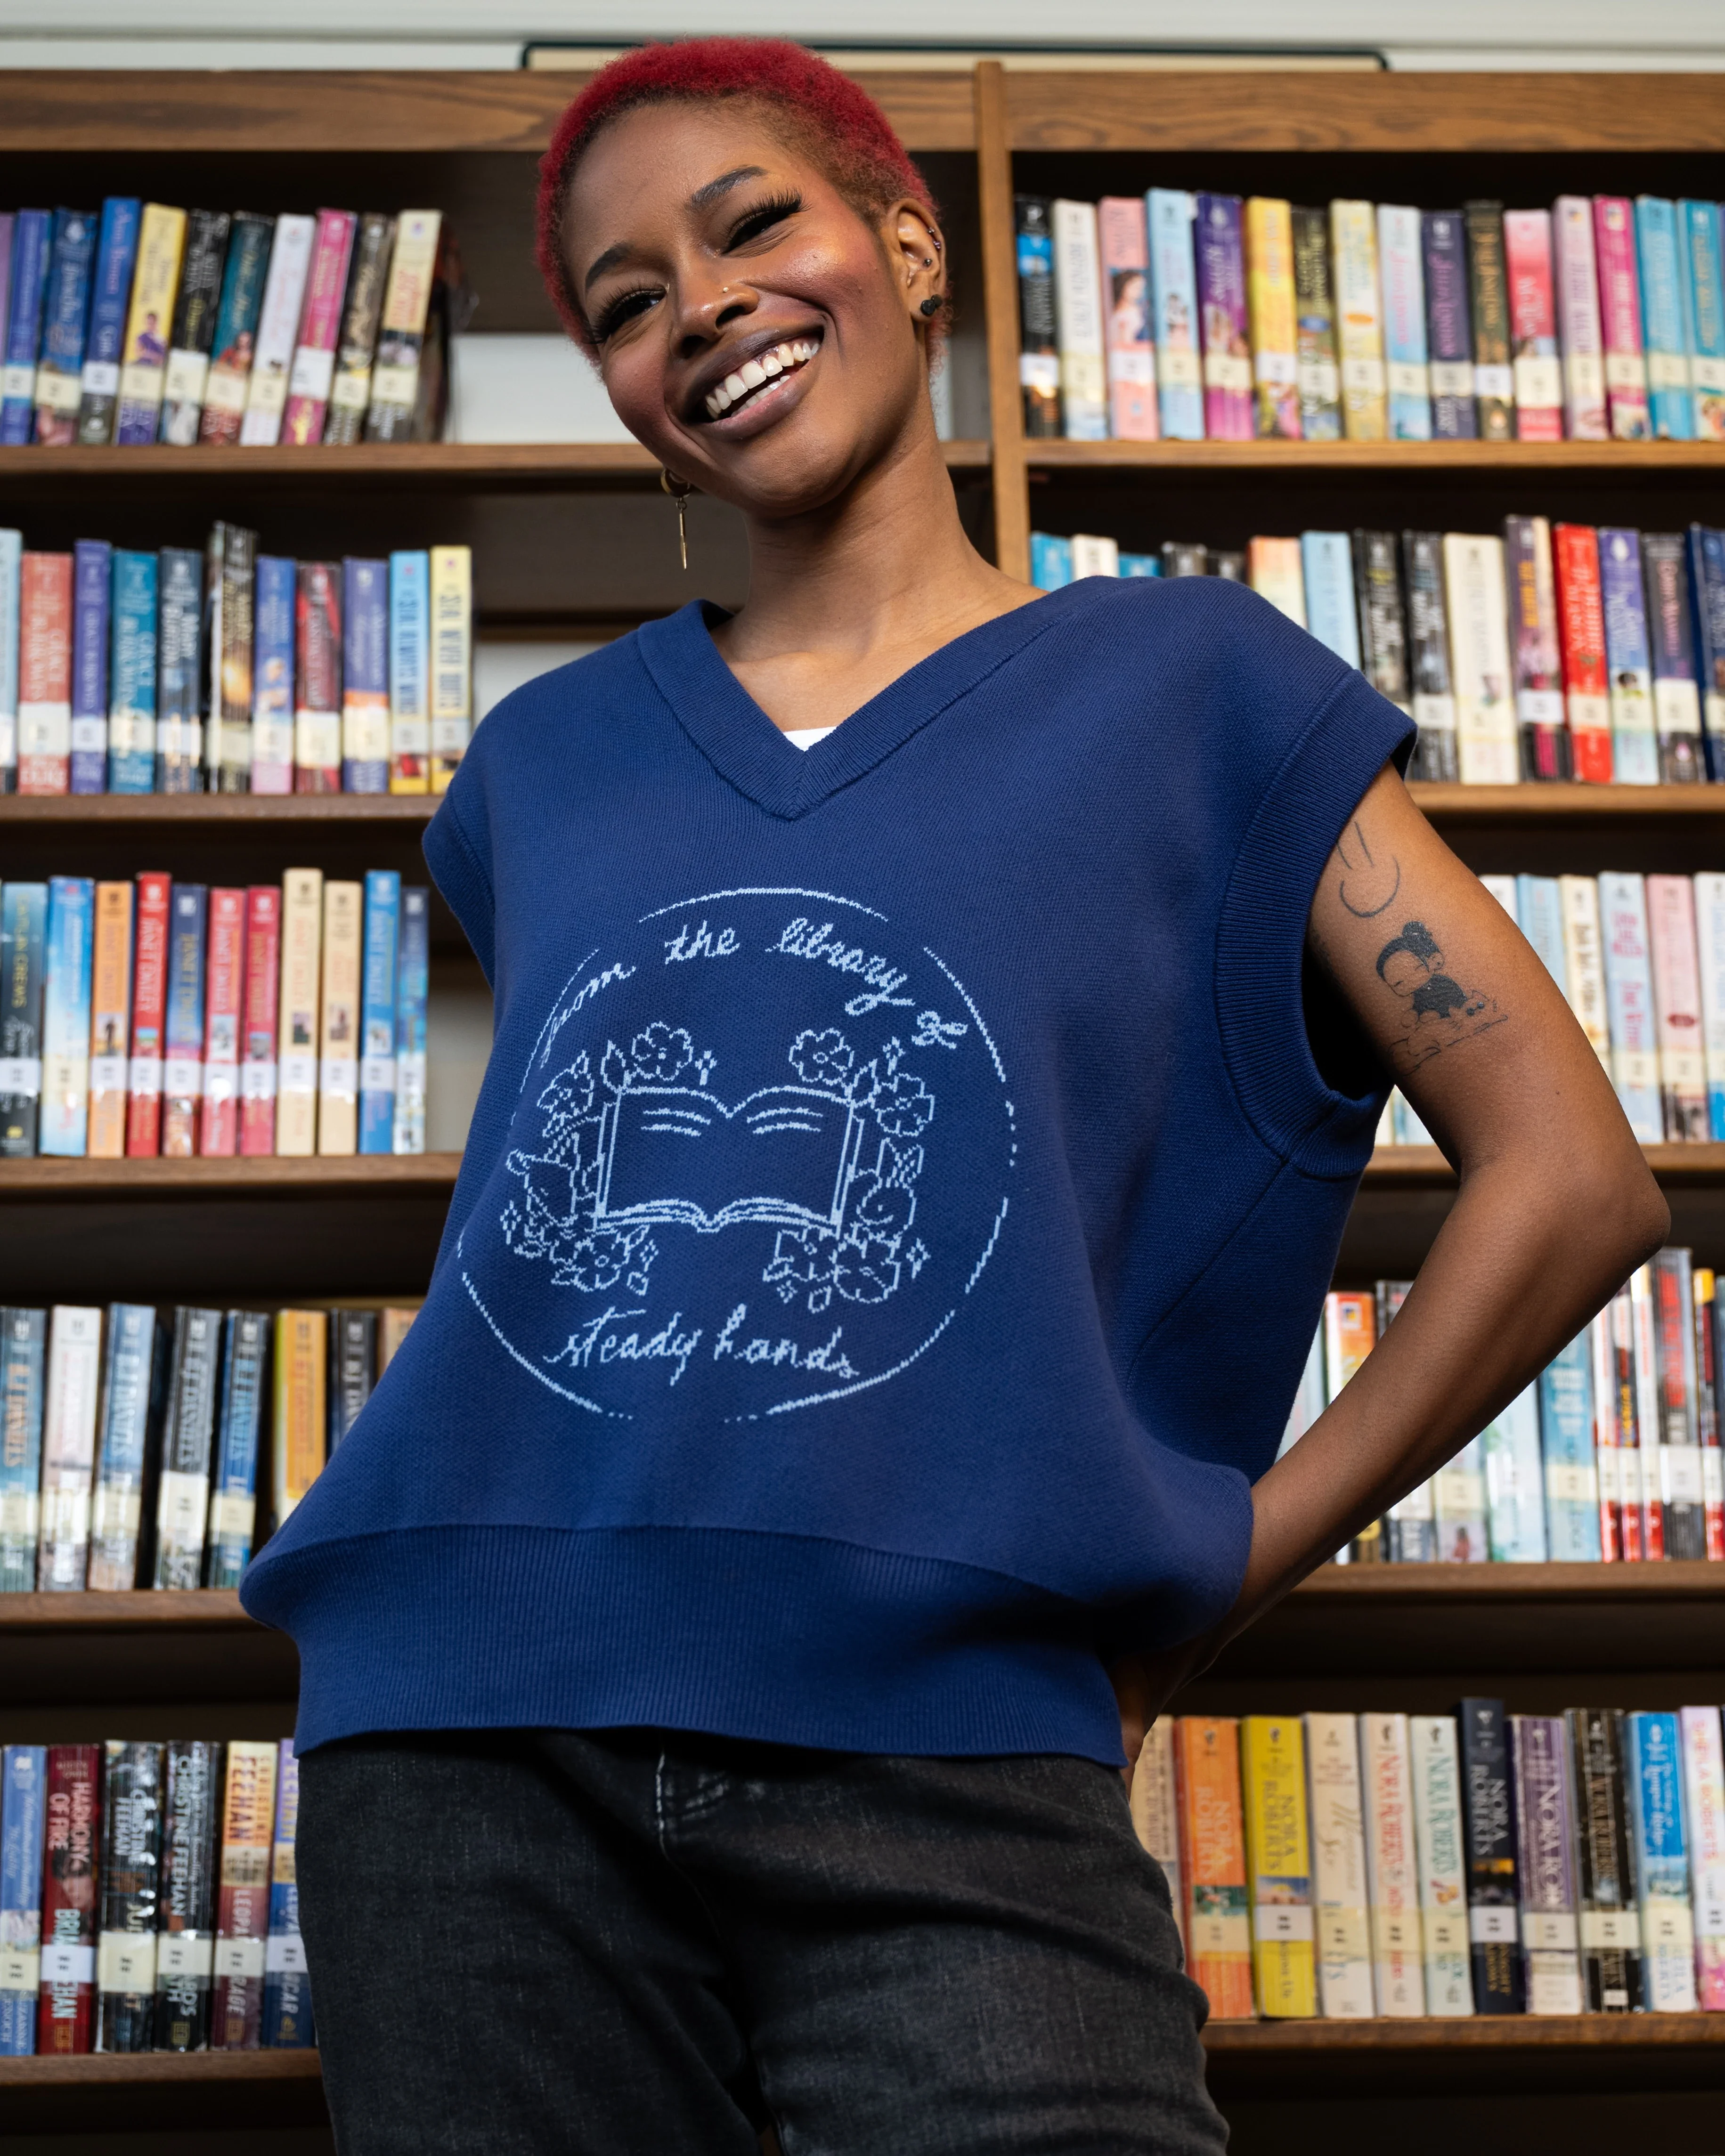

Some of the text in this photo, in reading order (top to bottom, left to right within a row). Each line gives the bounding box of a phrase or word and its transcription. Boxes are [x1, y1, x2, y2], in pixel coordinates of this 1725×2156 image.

[540, 918, 967, 1069] from the library of
[543, 1304, 859, 1386] steady hands
[228, 1756, 257, 1841] FEEHAN
[256, 1755, 271, 1843] CHRISTINE
[1379, 1752, 1401, 1800] NORA
[1427, 1755, 1458, 1873] NORA ROBERTS
[1470, 1764, 1492, 1856] ROBERTS
[1488, 1778, 1509, 1842] NORA
[1537, 1782, 1562, 1851] NORA
[1692, 1719, 1718, 1861] SHEILA ROBERTS
[48, 1792, 70, 1851] OF FIRE
[69, 1782, 92, 1863] HARMONY
[114, 1797, 132, 1856] FEEHAN
[170, 1755, 193, 1916] CHRISTINE FEEHAN
[1195, 1786, 1221, 1880] ROBERTS
[1213, 1800, 1233, 1865] NORA
[1262, 1780, 1284, 1872] ROBERTS
[1282, 1795, 1298, 1857] NORA
[1378, 1803, 1405, 1866] ROBERTS
[52, 1909, 81, 1946] BRIA
[227, 1976, 248, 2016] RAGE
